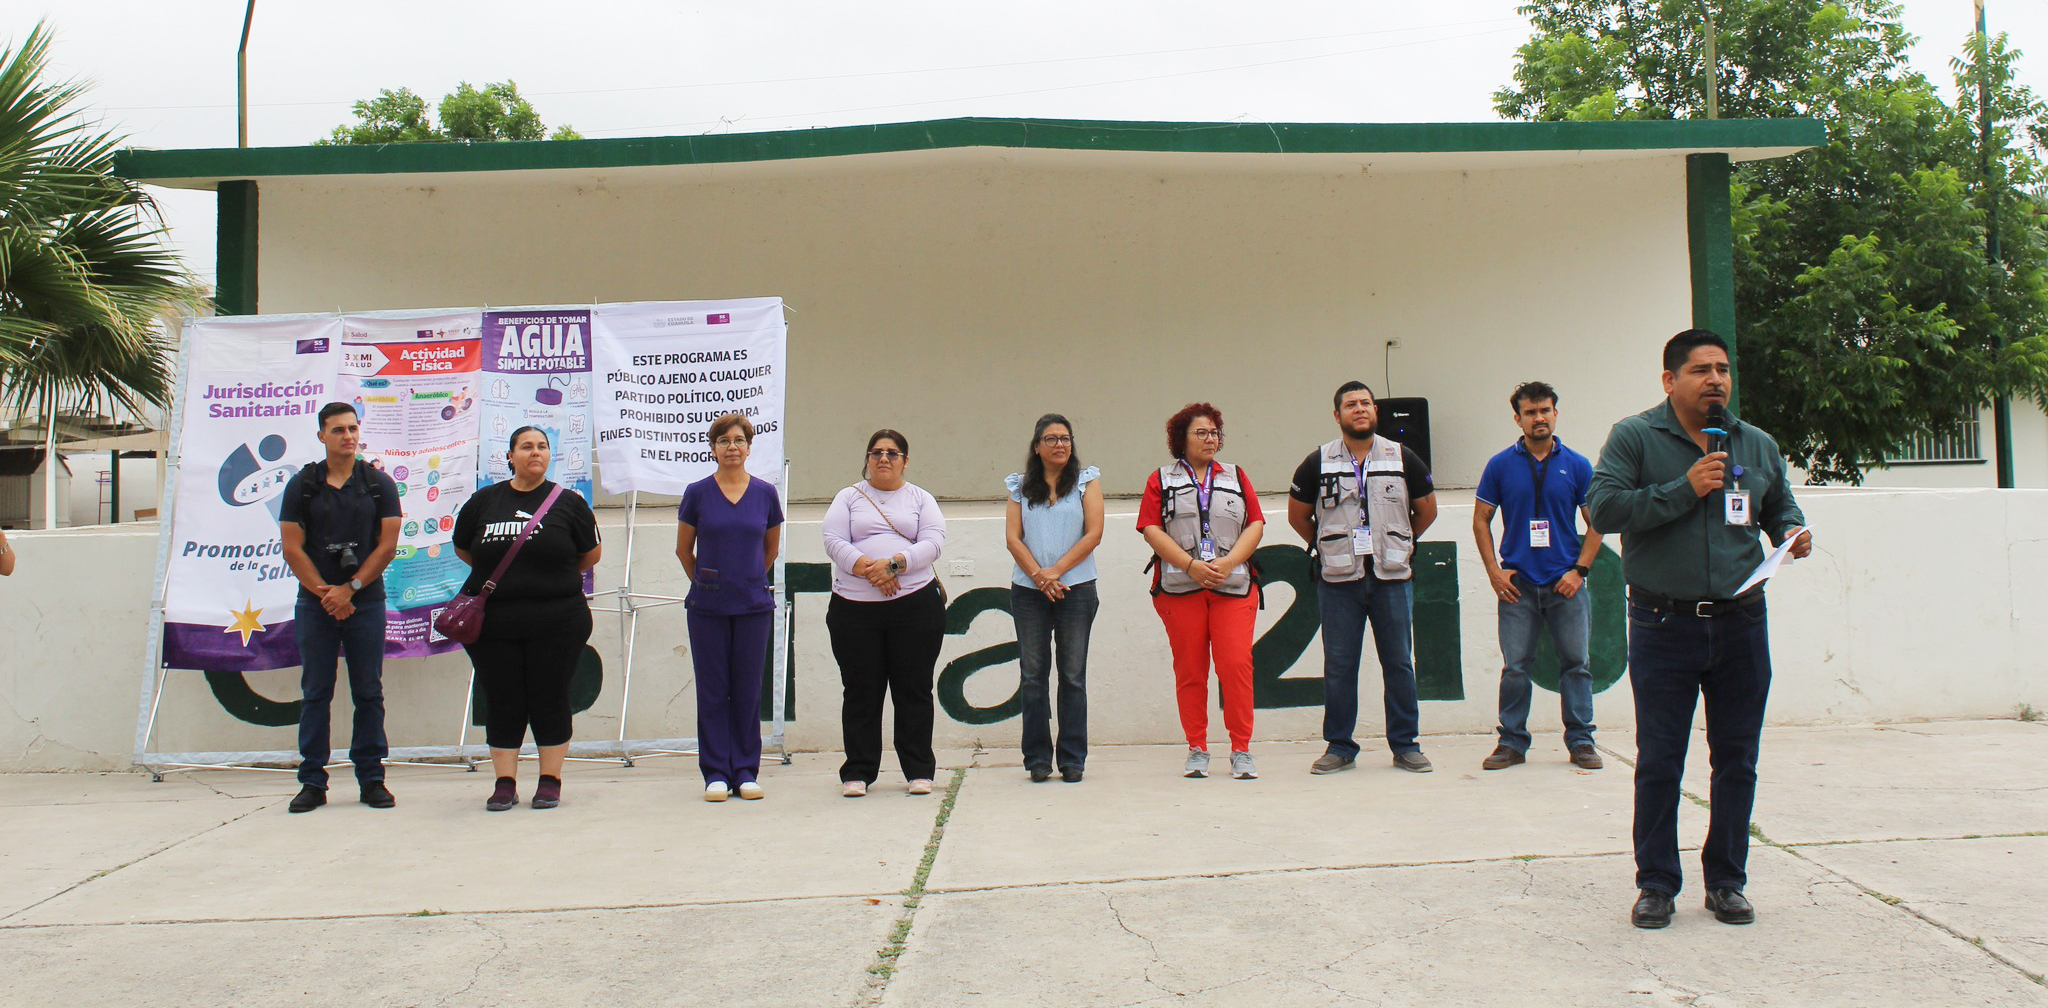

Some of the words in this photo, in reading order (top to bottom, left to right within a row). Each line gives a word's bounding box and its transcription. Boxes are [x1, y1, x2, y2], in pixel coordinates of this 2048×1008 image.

[498, 316, 545, 325] BENEFICIOS
[546, 316, 557, 324] DE
[558, 316, 587, 324] TOMAR
[499, 324, 585, 357] AGUA
[400, 346, 465, 360] Actividad
[633, 354, 662, 366] ESTE
[664, 350, 731, 364] PROGRAMA
[734, 349, 747, 360] ES
[412, 359, 452, 371] Física
[498, 358, 537, 370] SIMPLE
[538, 357, 586, 370] POTABLE
[607, 369, 655, 385] PÚBLICO
[658, 372, 696, 385] AJENO
[699, 372, 707, 382] A
[709, 364, 772, 382] CUALQUIER
[203, 380, 324, 399] Jurisdicción
[615, 390, 665, 404] PARTIDO
[667, 389, 724, 404] POLÍTICO,
[726, 386, 764, 401] QUEDA
[209, 400, 301, 418] Sanitaria
[305, 400, 316, 414] II
[620, 408, 684, 424] PROHIBIDO
[687, 412, 702, 424] SU
[600, 427, 632, 442] FINES
[634, 429, 696, 443] DISTINTOS
[385, 448, 411, 456] Niños
[418, 439, 466, 454] adolescentes
[641, 449, 655, 459] EN
[659, 450, 672, 461] EL
[481, 536, 532, 544] puma.cm
[183, 539, 283, 558] Promoció
[230, 561, 244, 571] de
[247, 561, 258, 570] la
[257, 561, 296, 581] Salu
